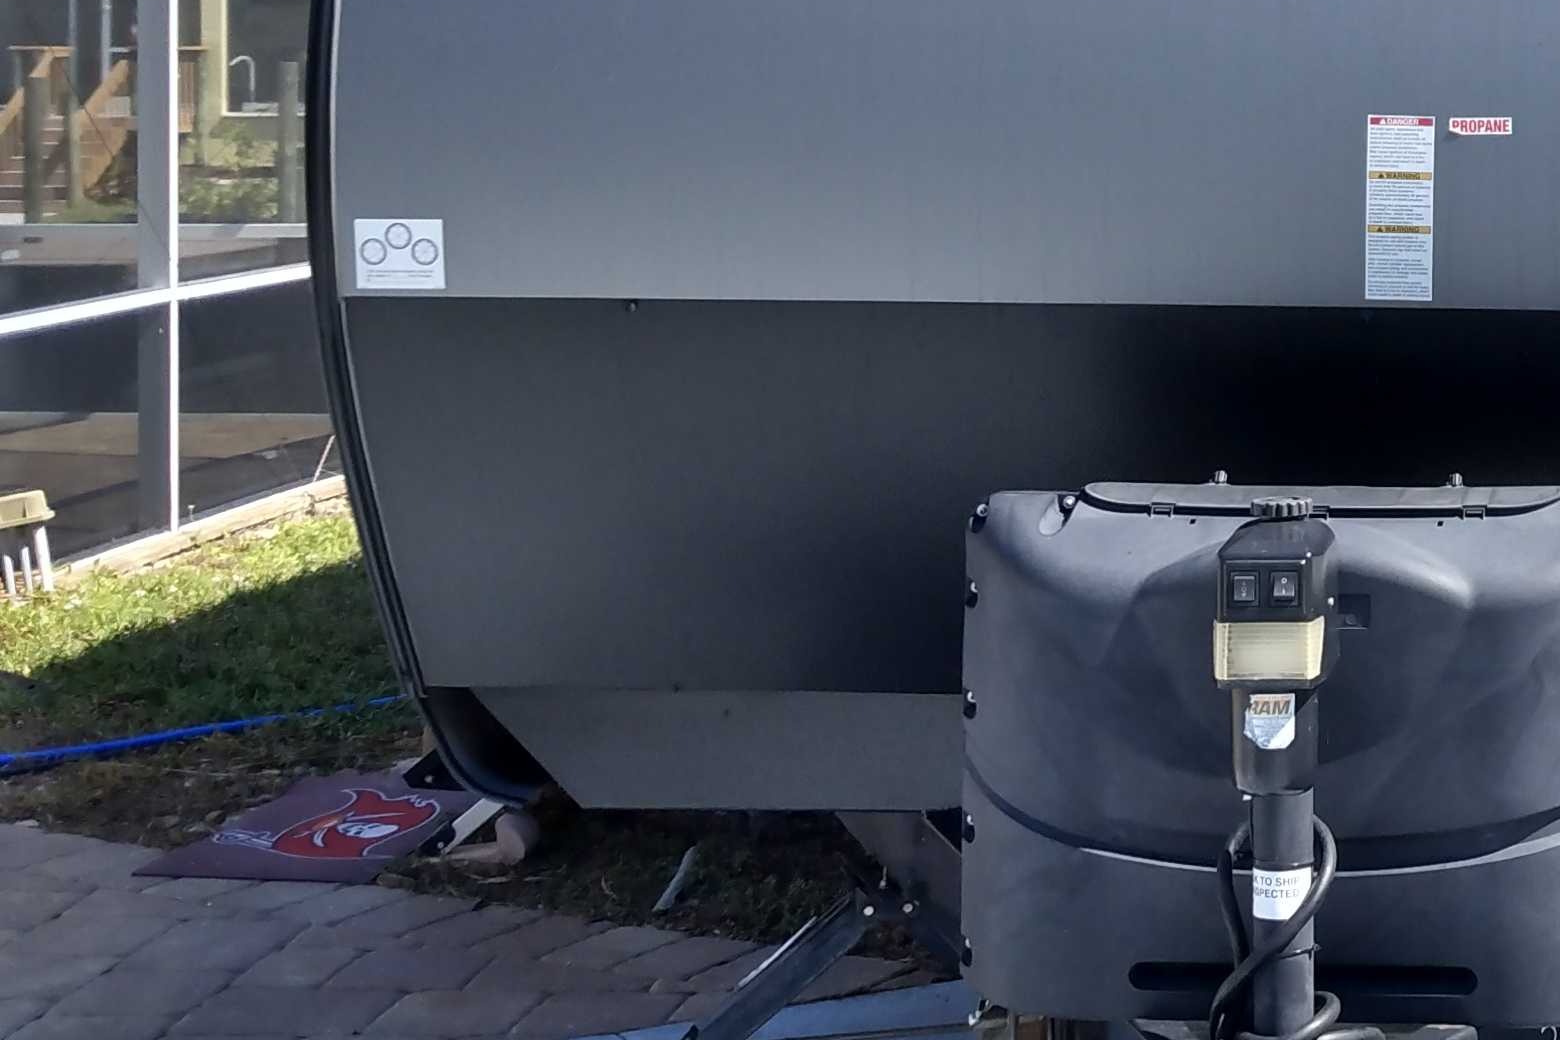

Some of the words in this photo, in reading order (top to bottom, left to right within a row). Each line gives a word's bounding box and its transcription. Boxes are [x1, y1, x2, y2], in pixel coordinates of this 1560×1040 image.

[1451, 119, 1511, 133] PROPANE
[1386, 172, 1421, 180] WARNING
[1384, 225, 1420, 233] WARNING
[1260, 875, 1273, 886] TO
